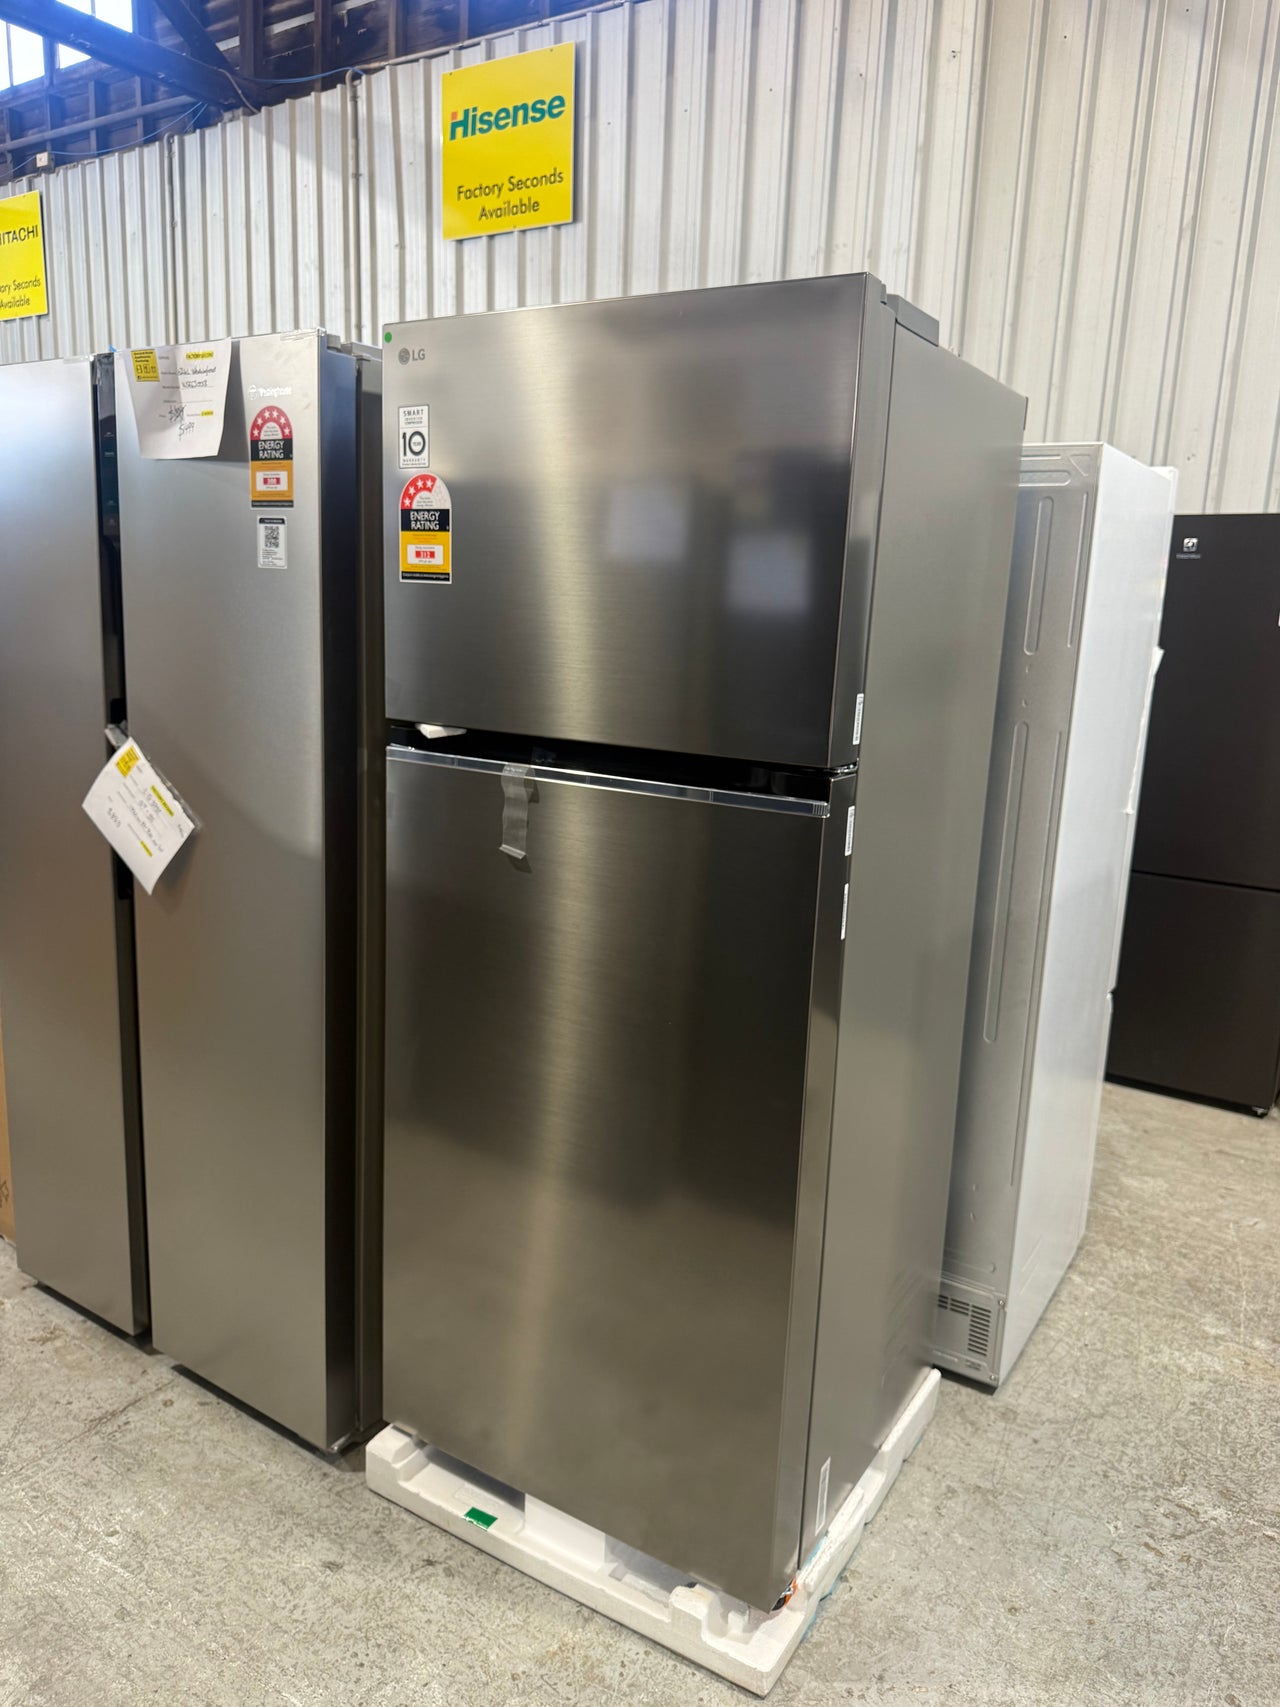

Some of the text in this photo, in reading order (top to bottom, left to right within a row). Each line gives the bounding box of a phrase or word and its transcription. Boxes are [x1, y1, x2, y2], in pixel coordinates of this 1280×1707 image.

[449, 95, 566, 141] Hisense
[457, 167, 564, 201] Factory Seconds
[478, 197, 540, 221] Available
[12, 275, 41, 291] Seconds
[412, 349, 426, 361] LG
[403, 409, 424, 417] SMART
[258, 441, 284, 450] ENERGY
[402, 431, 426, 457] 10
[259, 450, 284, 459] RATING
[410, 511, 440, 521] ENERGY
[411, 521, 439, 530] RATING
